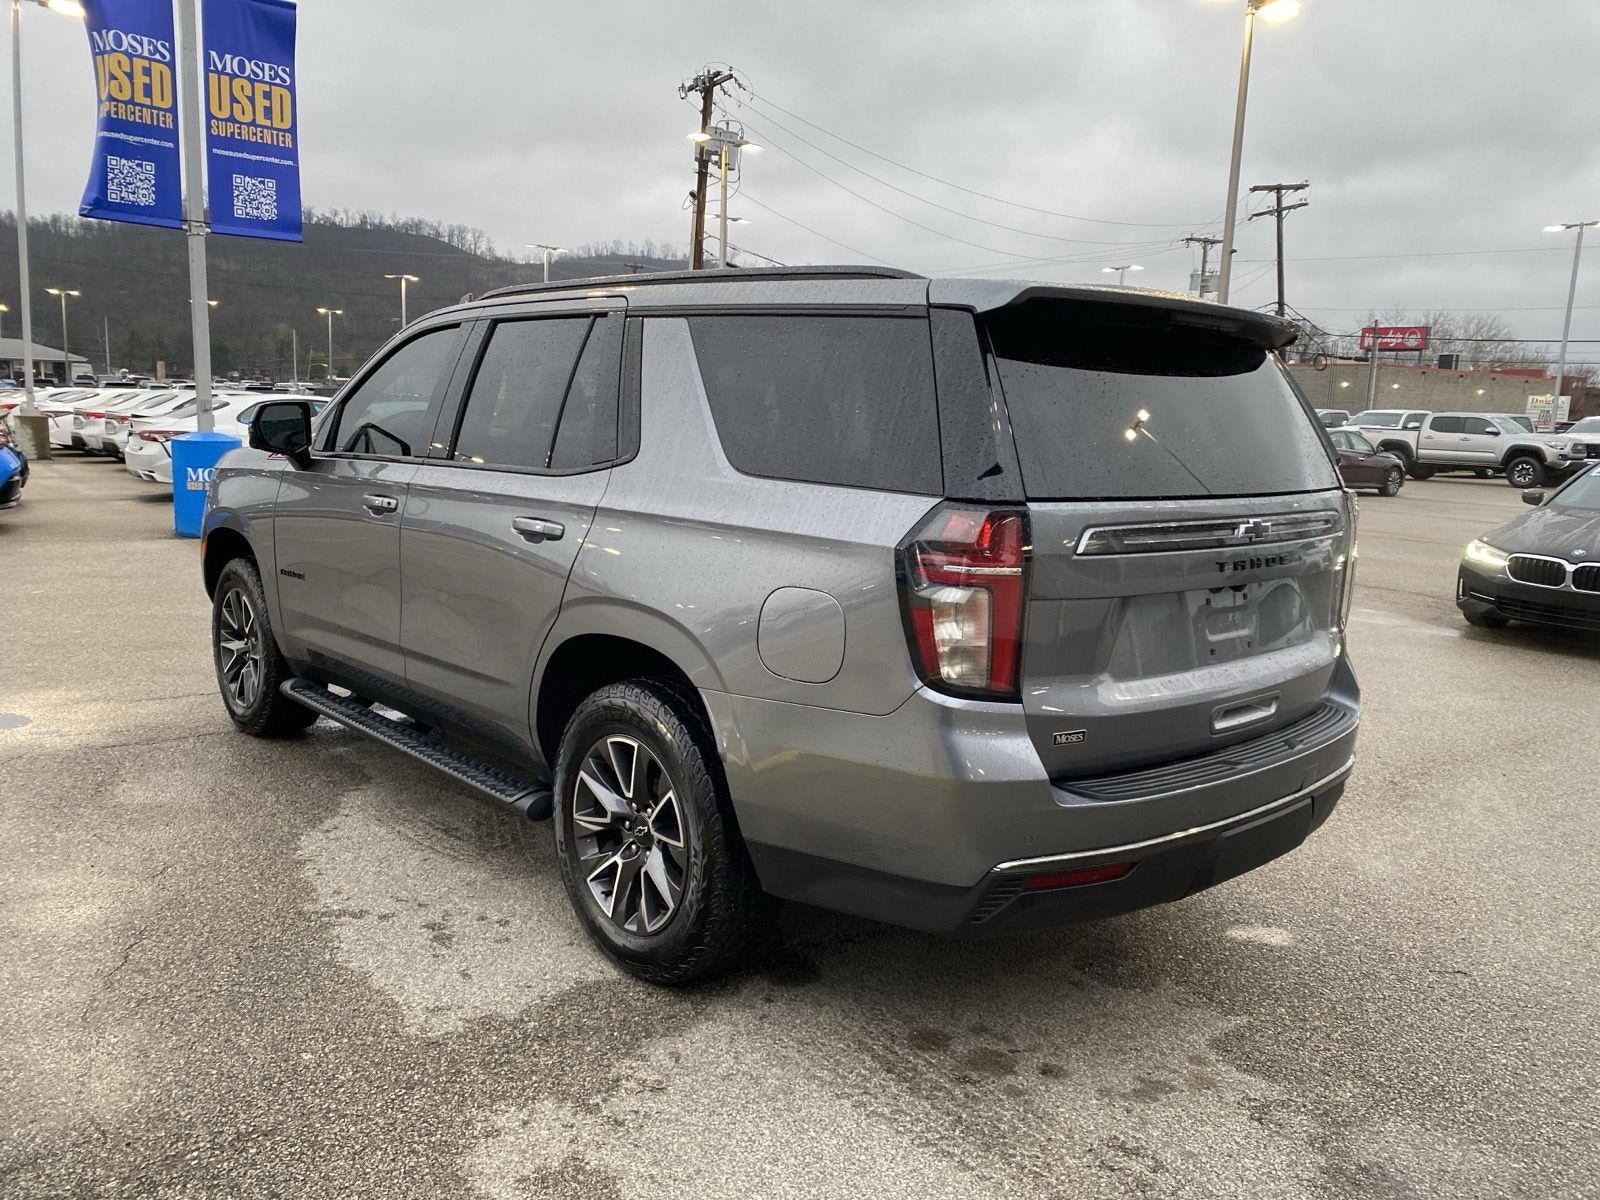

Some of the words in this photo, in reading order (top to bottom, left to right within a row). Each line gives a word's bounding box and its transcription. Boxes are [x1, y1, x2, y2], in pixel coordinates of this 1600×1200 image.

[91, 29, 170, 62] MOSES
[96, 52, 172, 110] USED
[209, 50, 290, 85] MOSES
[98, 100, 173, 129] PERCENTER
[209, 73, 292, 129] USED
[211, 119, 292, 148] SUPERCENTER
[212, 148, 294, 166] mosesusedsupercenter.com
[1364, 329, 1403, 347] Wndy's
[1216, 554, 1289, 573] TAHOE
[1056, 733, 1083, 745] MOSES
